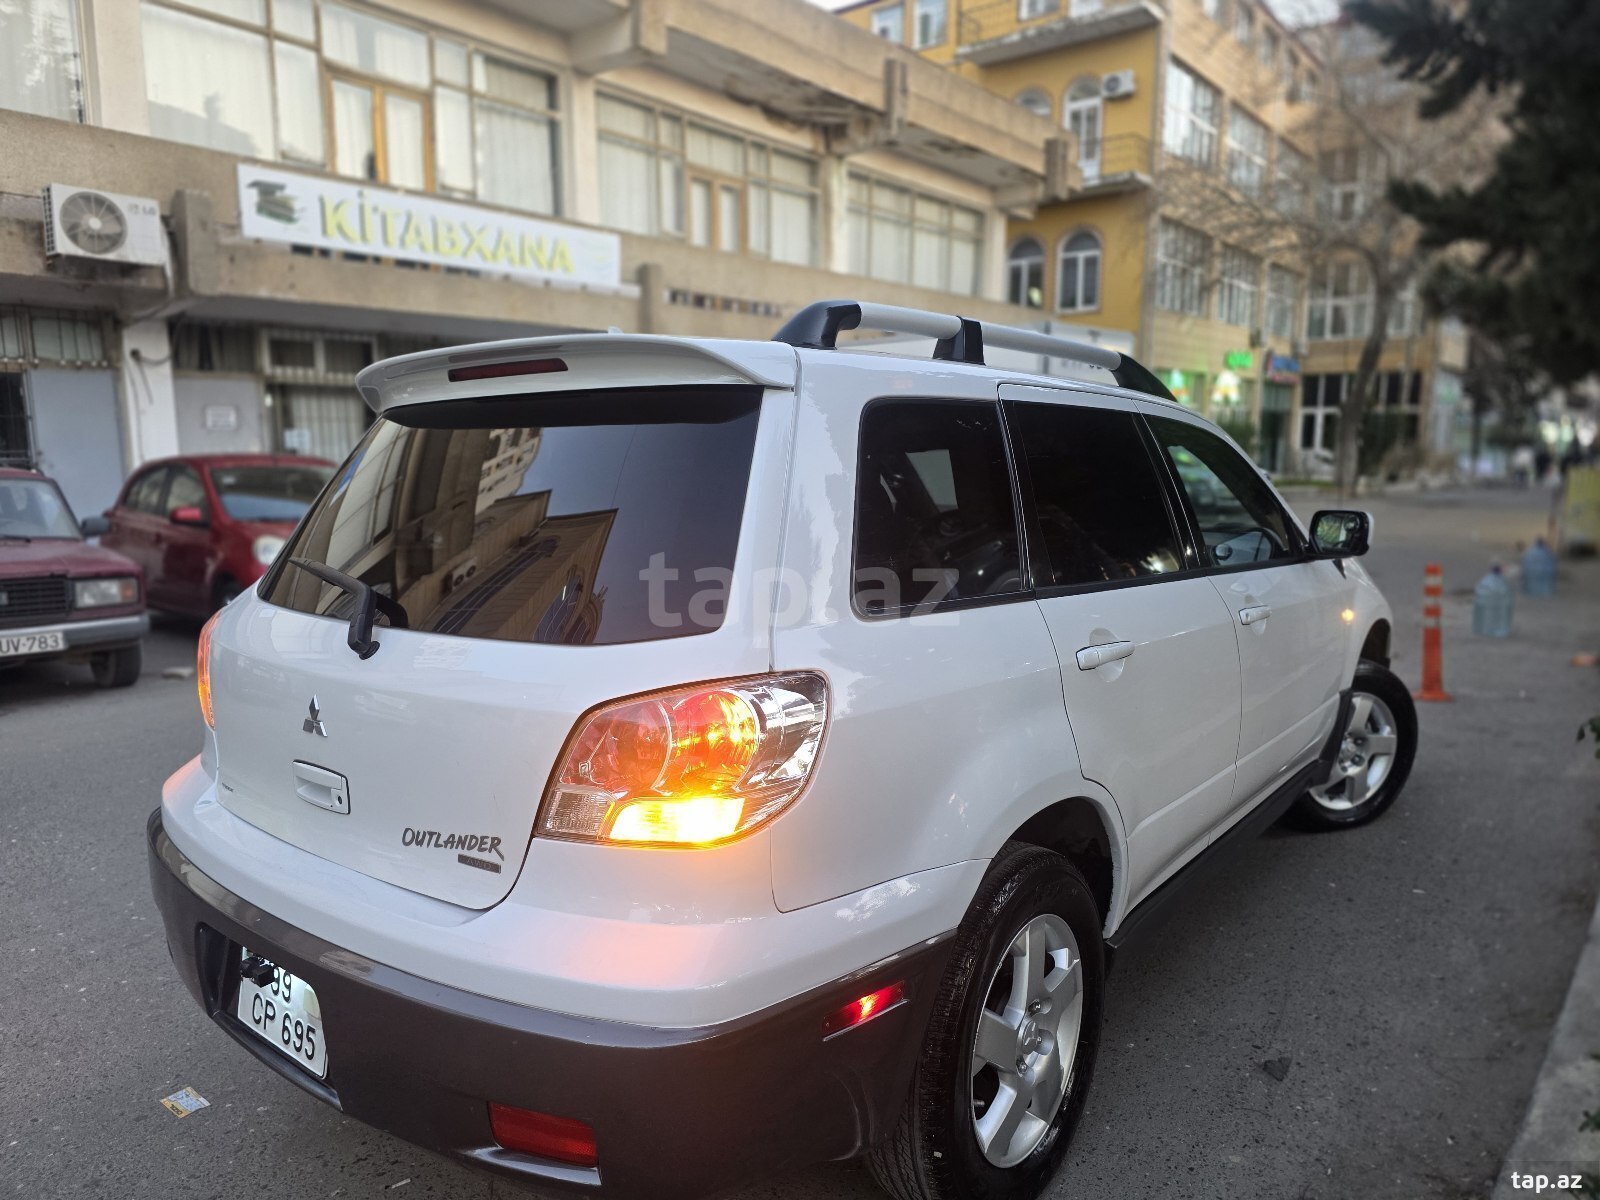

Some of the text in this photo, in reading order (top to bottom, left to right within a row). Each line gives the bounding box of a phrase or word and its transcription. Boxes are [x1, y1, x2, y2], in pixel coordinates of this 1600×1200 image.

[319, 190, 574, 274] KİTABXANA
[402, 827, 505, 861] OUTLANDER
[252, 992, 316, 1060] CP 695
